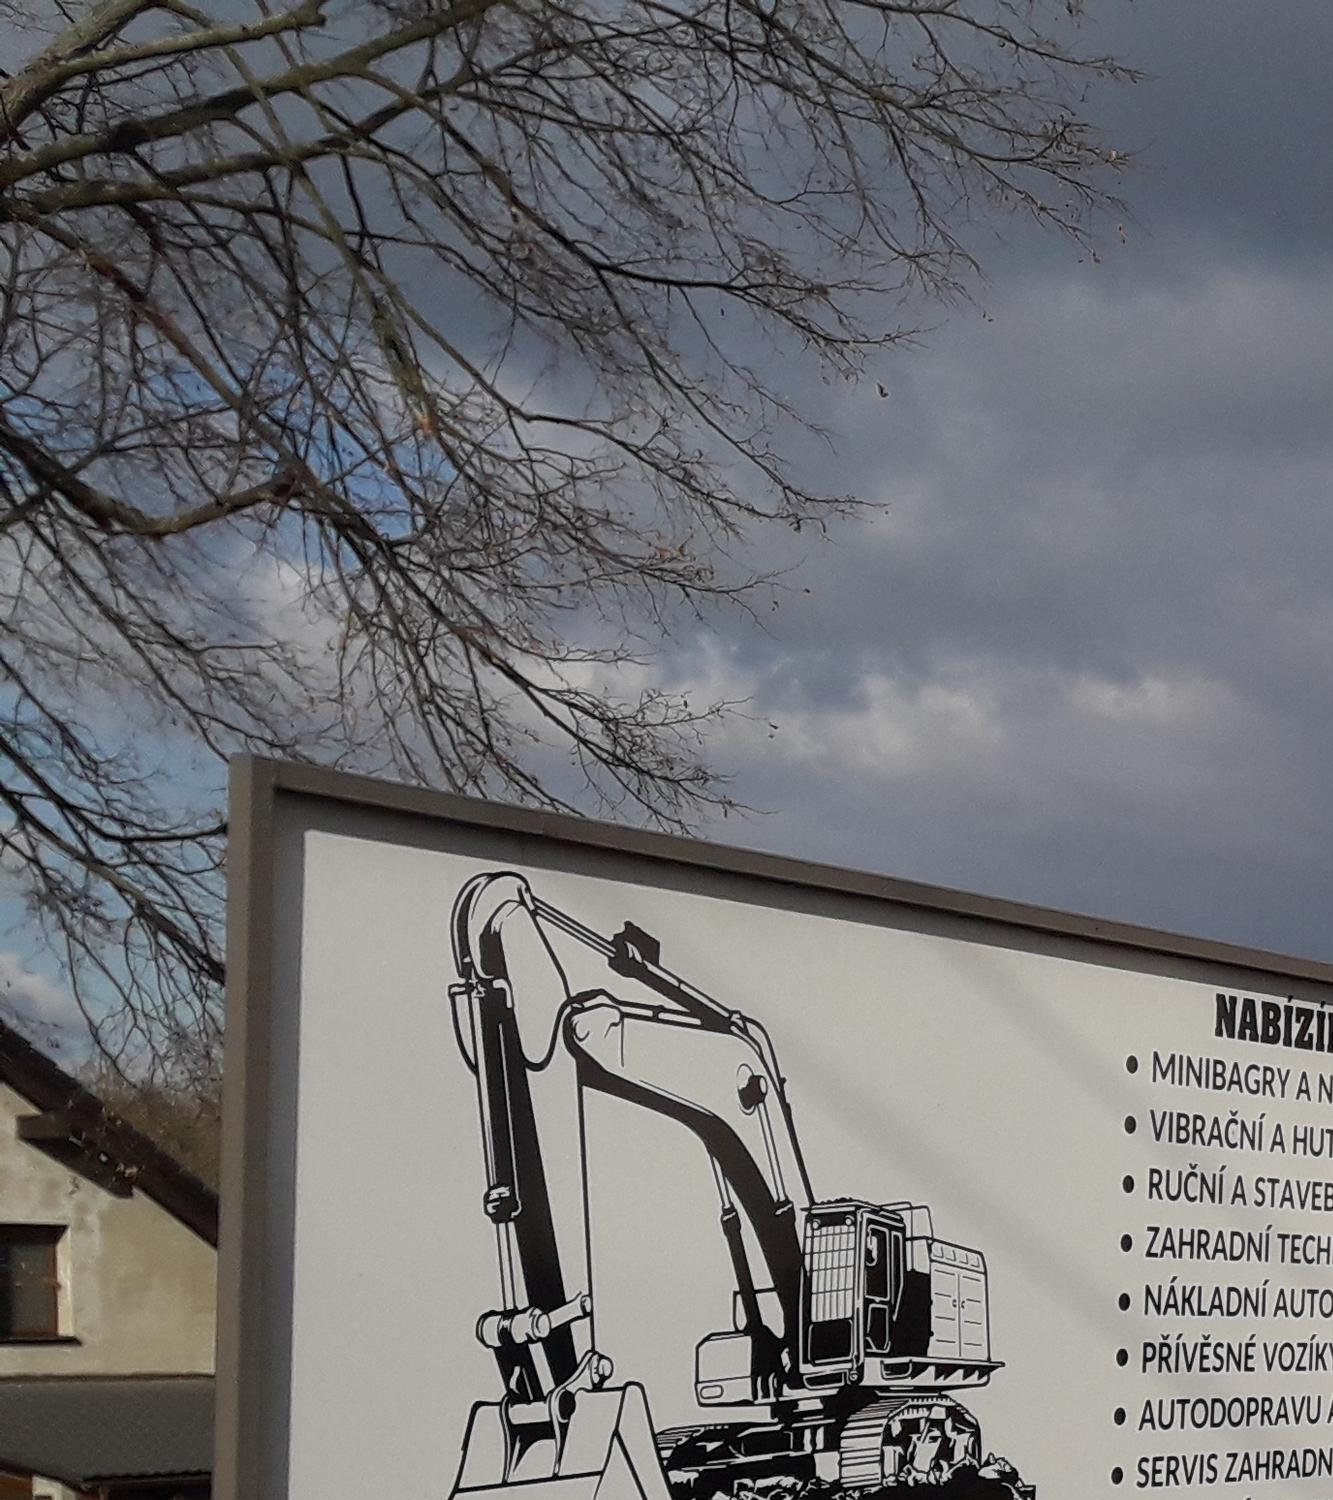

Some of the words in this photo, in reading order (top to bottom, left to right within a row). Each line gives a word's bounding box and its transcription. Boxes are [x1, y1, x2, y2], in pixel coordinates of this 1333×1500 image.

[1151, 1051, 1291, 1099] MINIBAGRY
[1295, 1071, 1312, 1102] A
[1150, 1109, 1266, 1152] VIBRAČNÍ
[1270, 1123, 1286, 1154] A
[1148, 1163, 1227, 1204] RUČNÍ
[1231, 1176, 1247, 1207] A
[1145, 1224, 1273, 1263] ZAHRADNÍ
[1144, 1276, 1270, 1318] NÁKLADNÍ
[1141, 1333, 1257, 1374] PŘÍVĚSNÉ
[1138, 1394, 1323, 1432] AUTODOPRAVU
[1135, 1452, 1218, 1488] SERVIS
